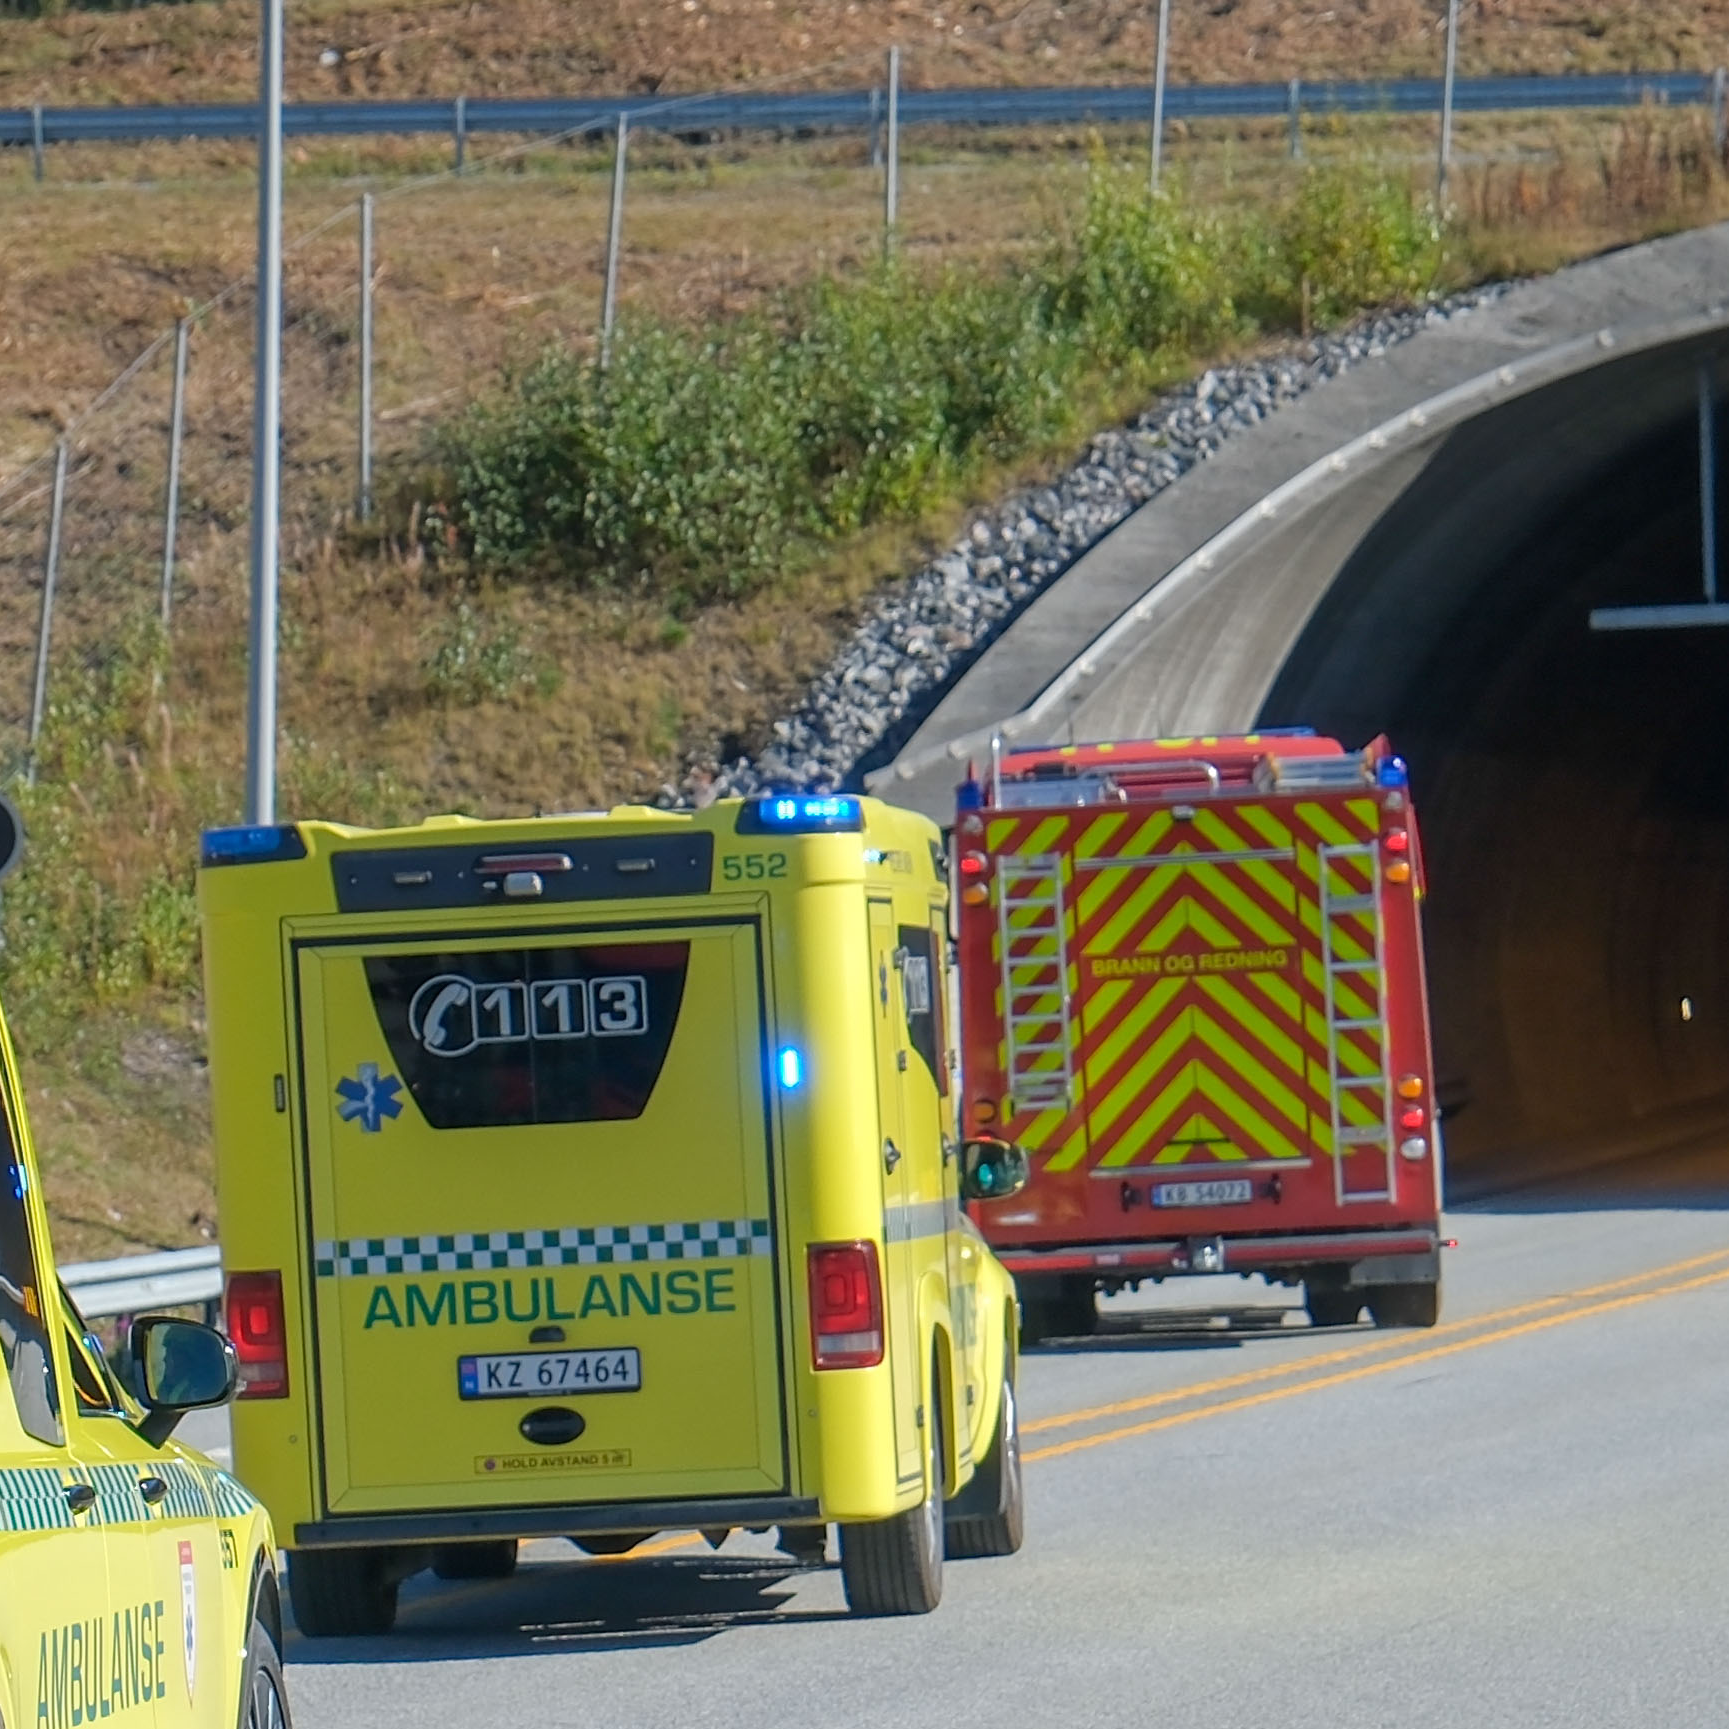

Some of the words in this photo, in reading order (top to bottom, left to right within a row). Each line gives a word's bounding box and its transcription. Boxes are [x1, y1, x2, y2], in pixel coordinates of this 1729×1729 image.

[721, 852, 788, 882] 552
[1091, 957, 1161, 977] BRANN
[1164, 954, 1194, 972] OG
[1199, 949, 1288, 970] REDNING
[481, 981, 639, 1036] 113
[363, 1268, 736, 1330] AMBULANSE
[487, 1361, 522, 1388] KZ
[537, 1356, 629, 1386] 67464
[502, 1458, 537, 1469] HOLD
[540, 1455, 598, 1467] AVSTAND
